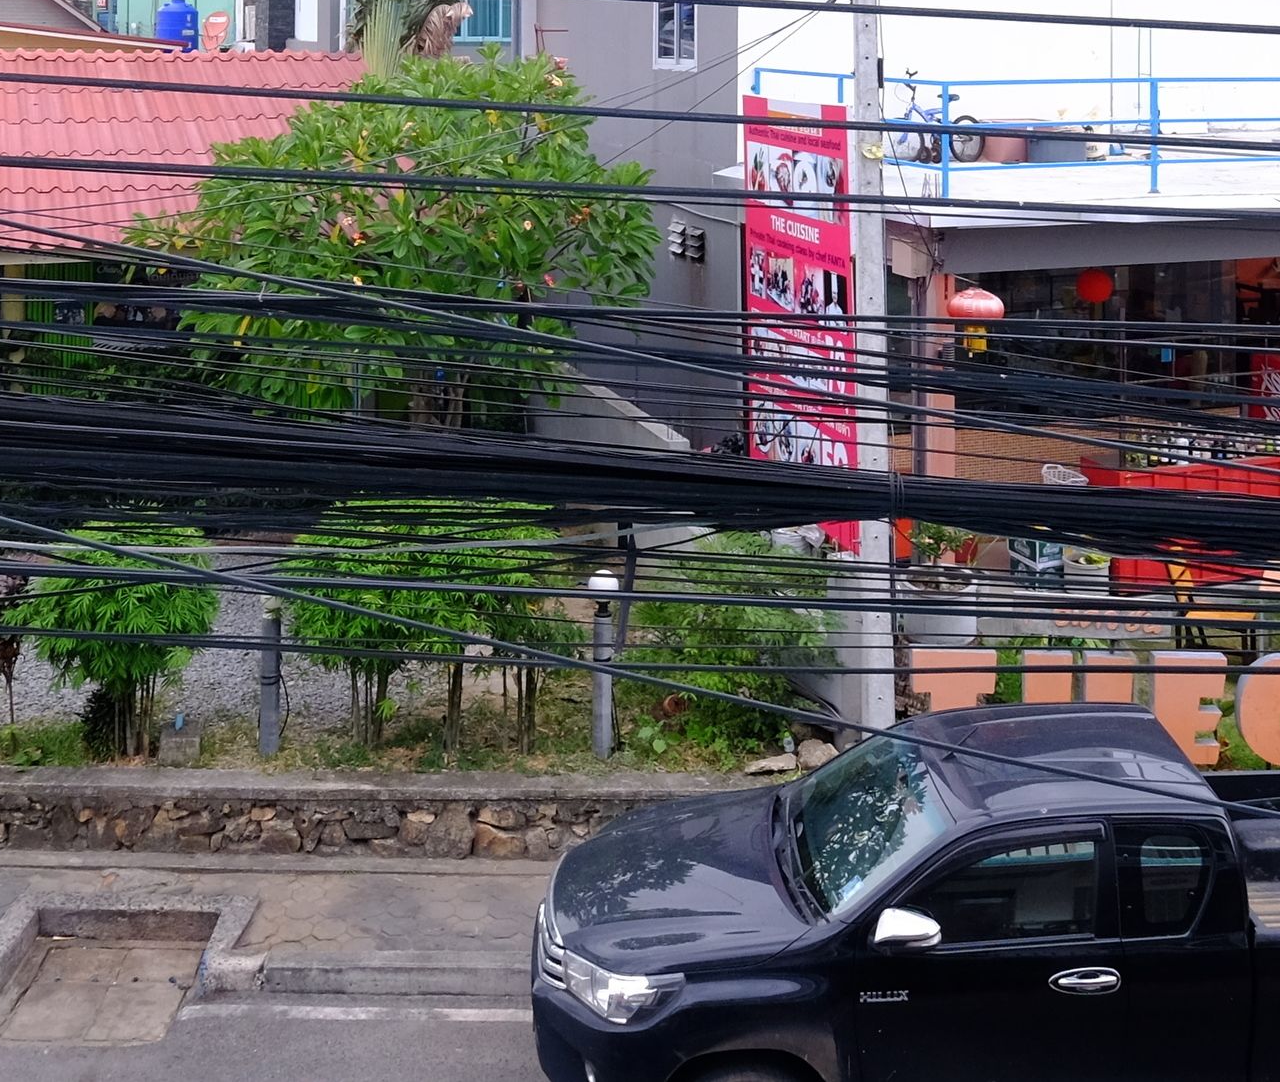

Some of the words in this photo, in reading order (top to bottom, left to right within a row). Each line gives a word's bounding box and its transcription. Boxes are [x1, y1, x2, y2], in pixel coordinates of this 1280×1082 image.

[770, 214, 785, 234] THE
[786, 220, 820, 244] CUISINE
[859, 990, 909, 1003] HILUX
